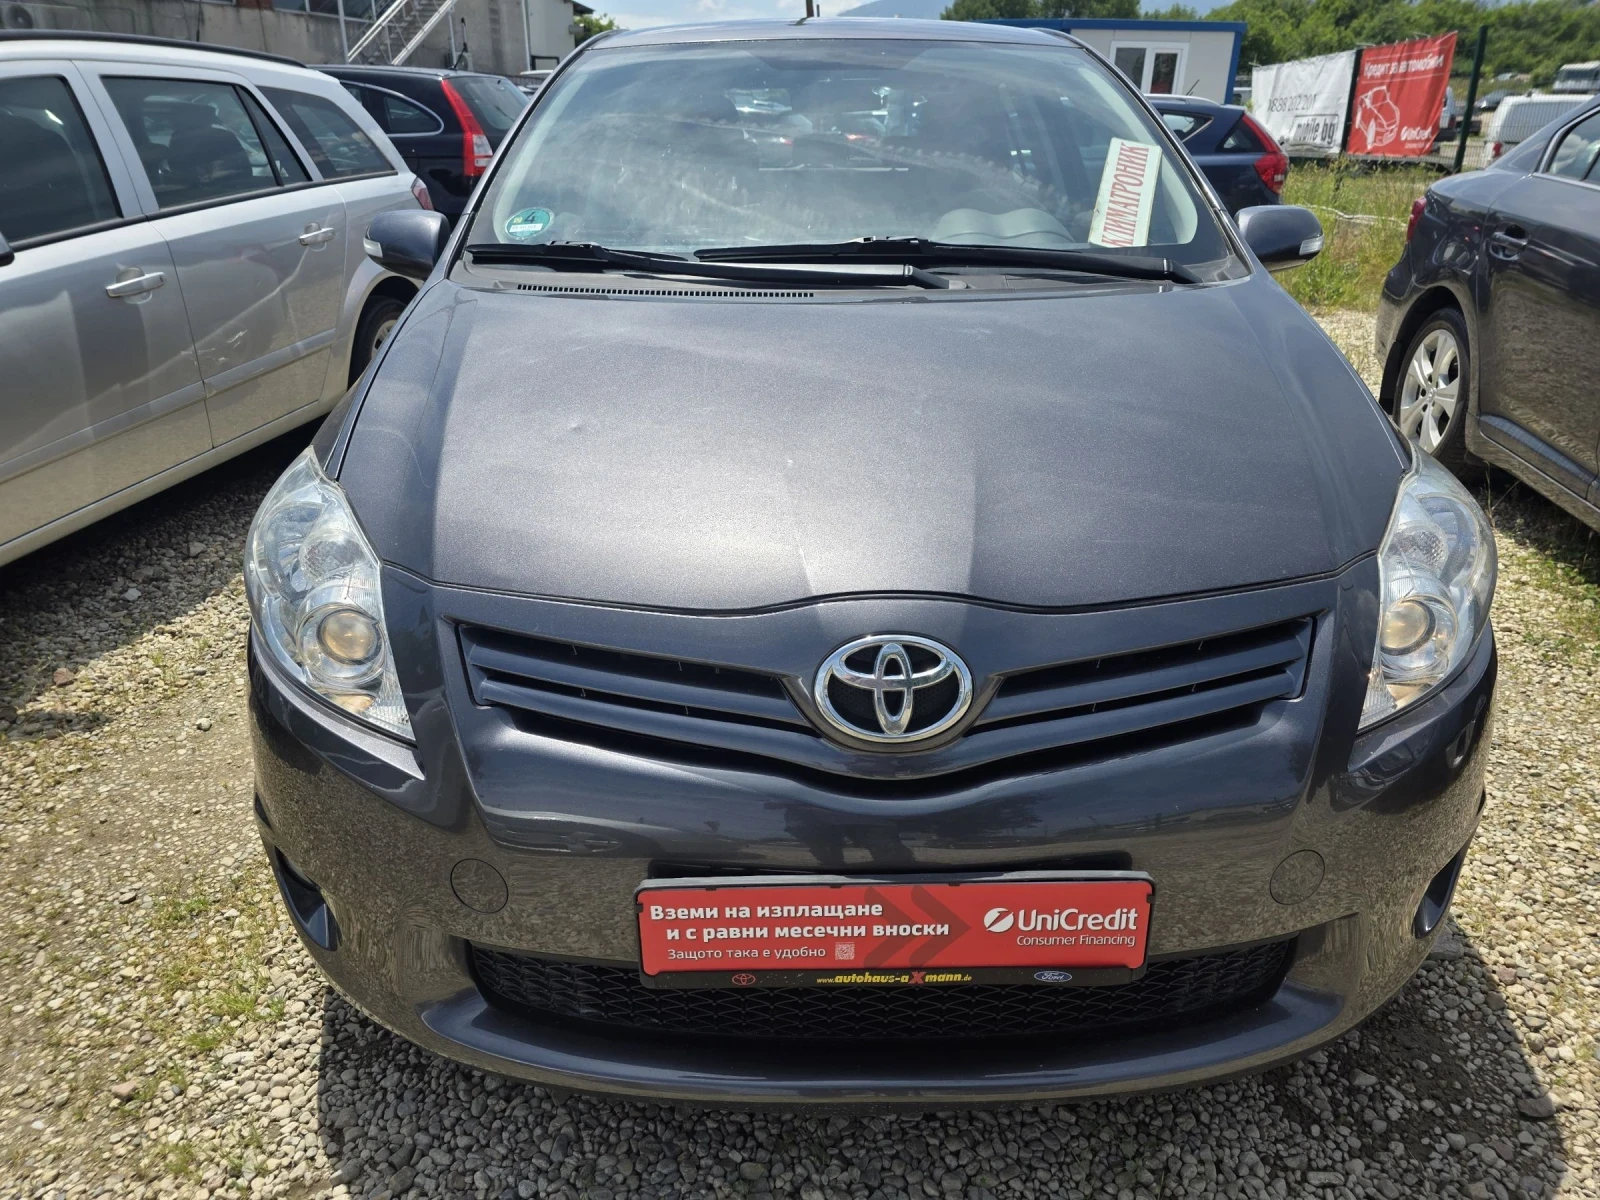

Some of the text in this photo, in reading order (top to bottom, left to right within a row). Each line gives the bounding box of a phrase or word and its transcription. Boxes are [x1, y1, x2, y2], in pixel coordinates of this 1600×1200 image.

[1101, 142, 1150, 247] КЛИМАТРОНИК
[523, 211, 536, 223] 4
[650, 903, 883, 920] Вземи на изплащане
[1017, 908, 1138, 931] UniCredit
[666, 923, 950, 943] и с равни месечни вноски
[1016, 934, 1136, 947] Consumer Financing
[667, 946, 826, 961] Защото така е удобно
